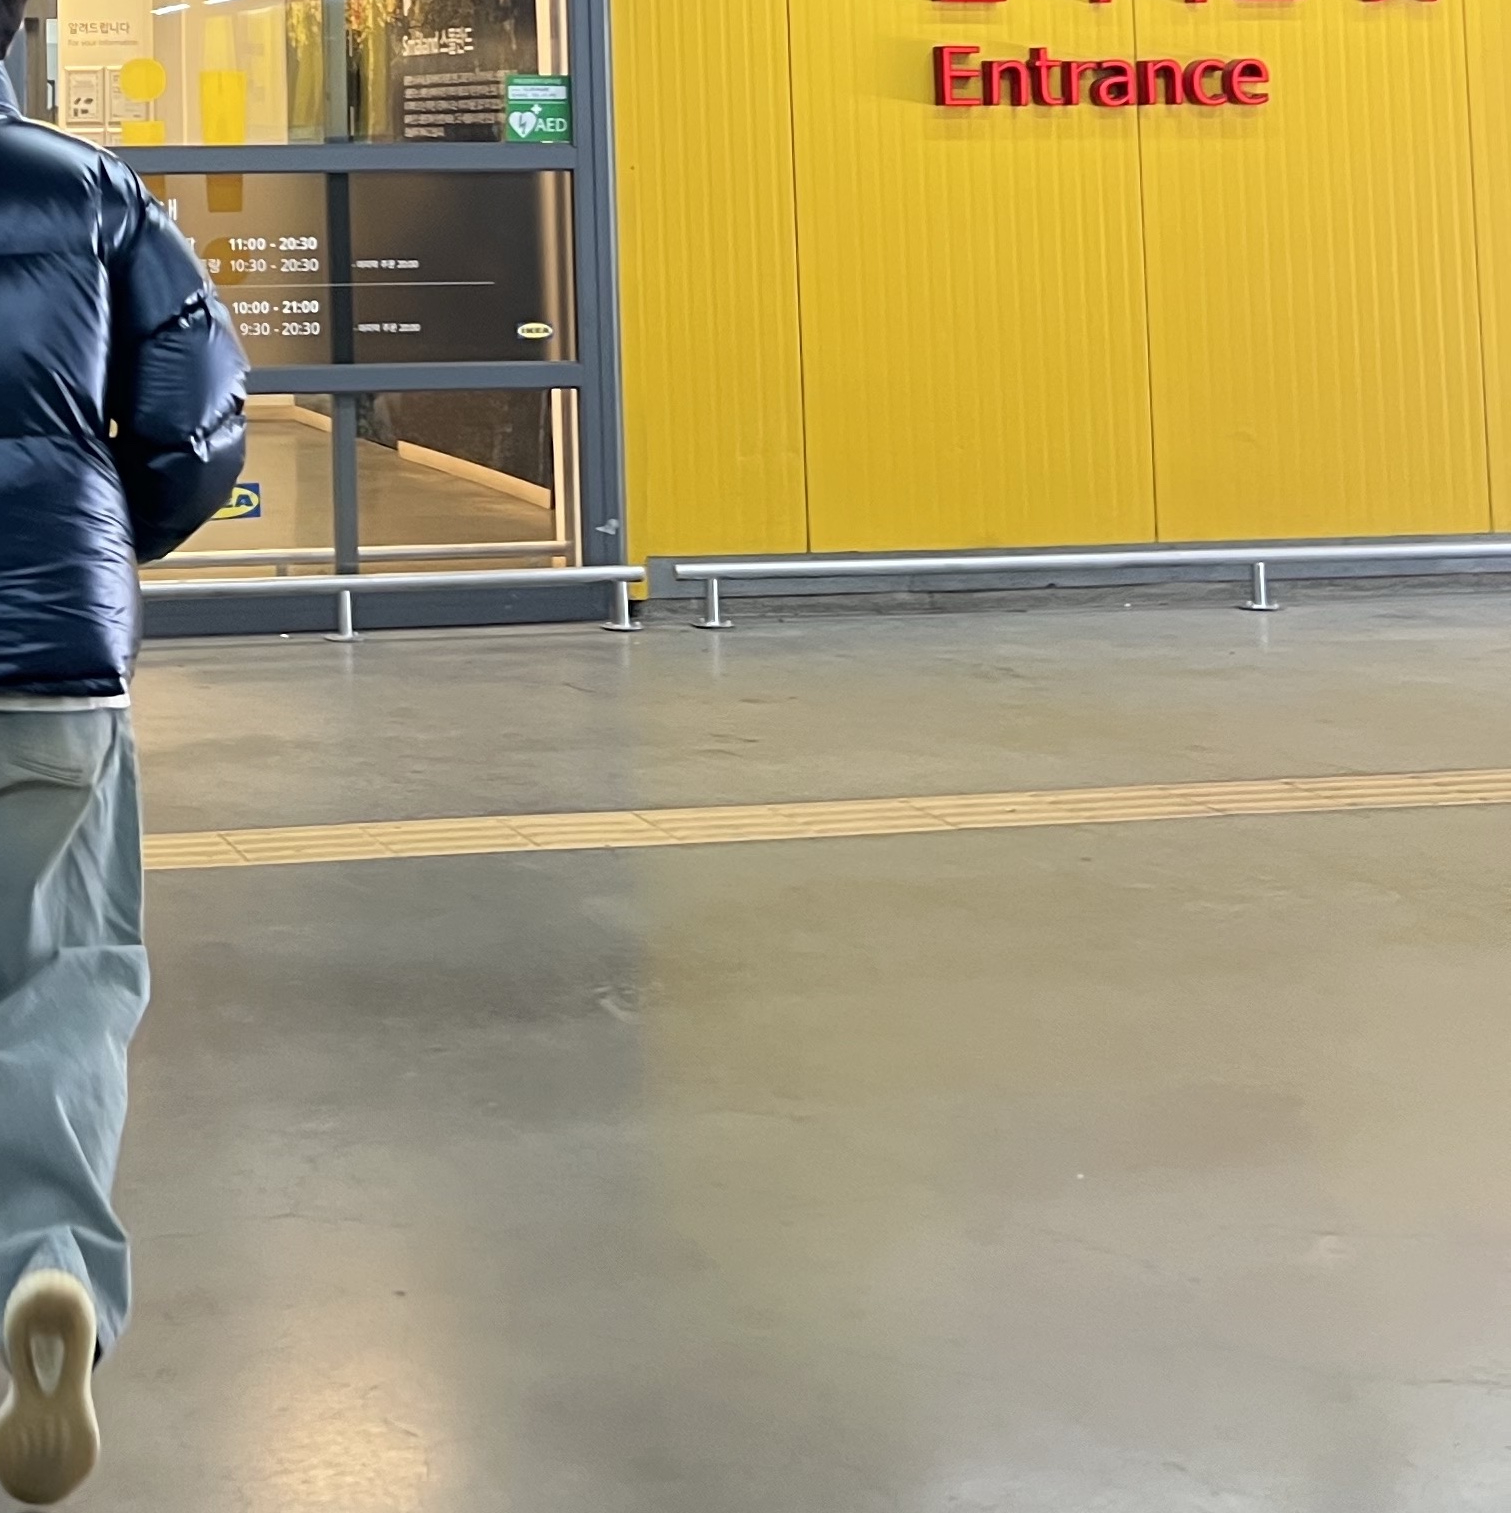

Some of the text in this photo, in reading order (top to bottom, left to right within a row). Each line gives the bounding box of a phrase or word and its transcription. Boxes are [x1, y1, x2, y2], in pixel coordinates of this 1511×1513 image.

[68, 21, 131, 35] 알려드립니다
[932, 45, 1271, 108] Entrance
[535, 117, 568, 133] AED
[228, 237, 266, 251] 11:00
[278, 237, 318, 250] 20:30
[230, 258, 267, 272] 10:30
[280, 258, 319, 272] 20:30
[232, 300, 270, 314] 10:00
[282, 300, 320, 314] 21:00
[239, 322, 270, 336] 9:30
[281, 321, 320, 336] 20:30
